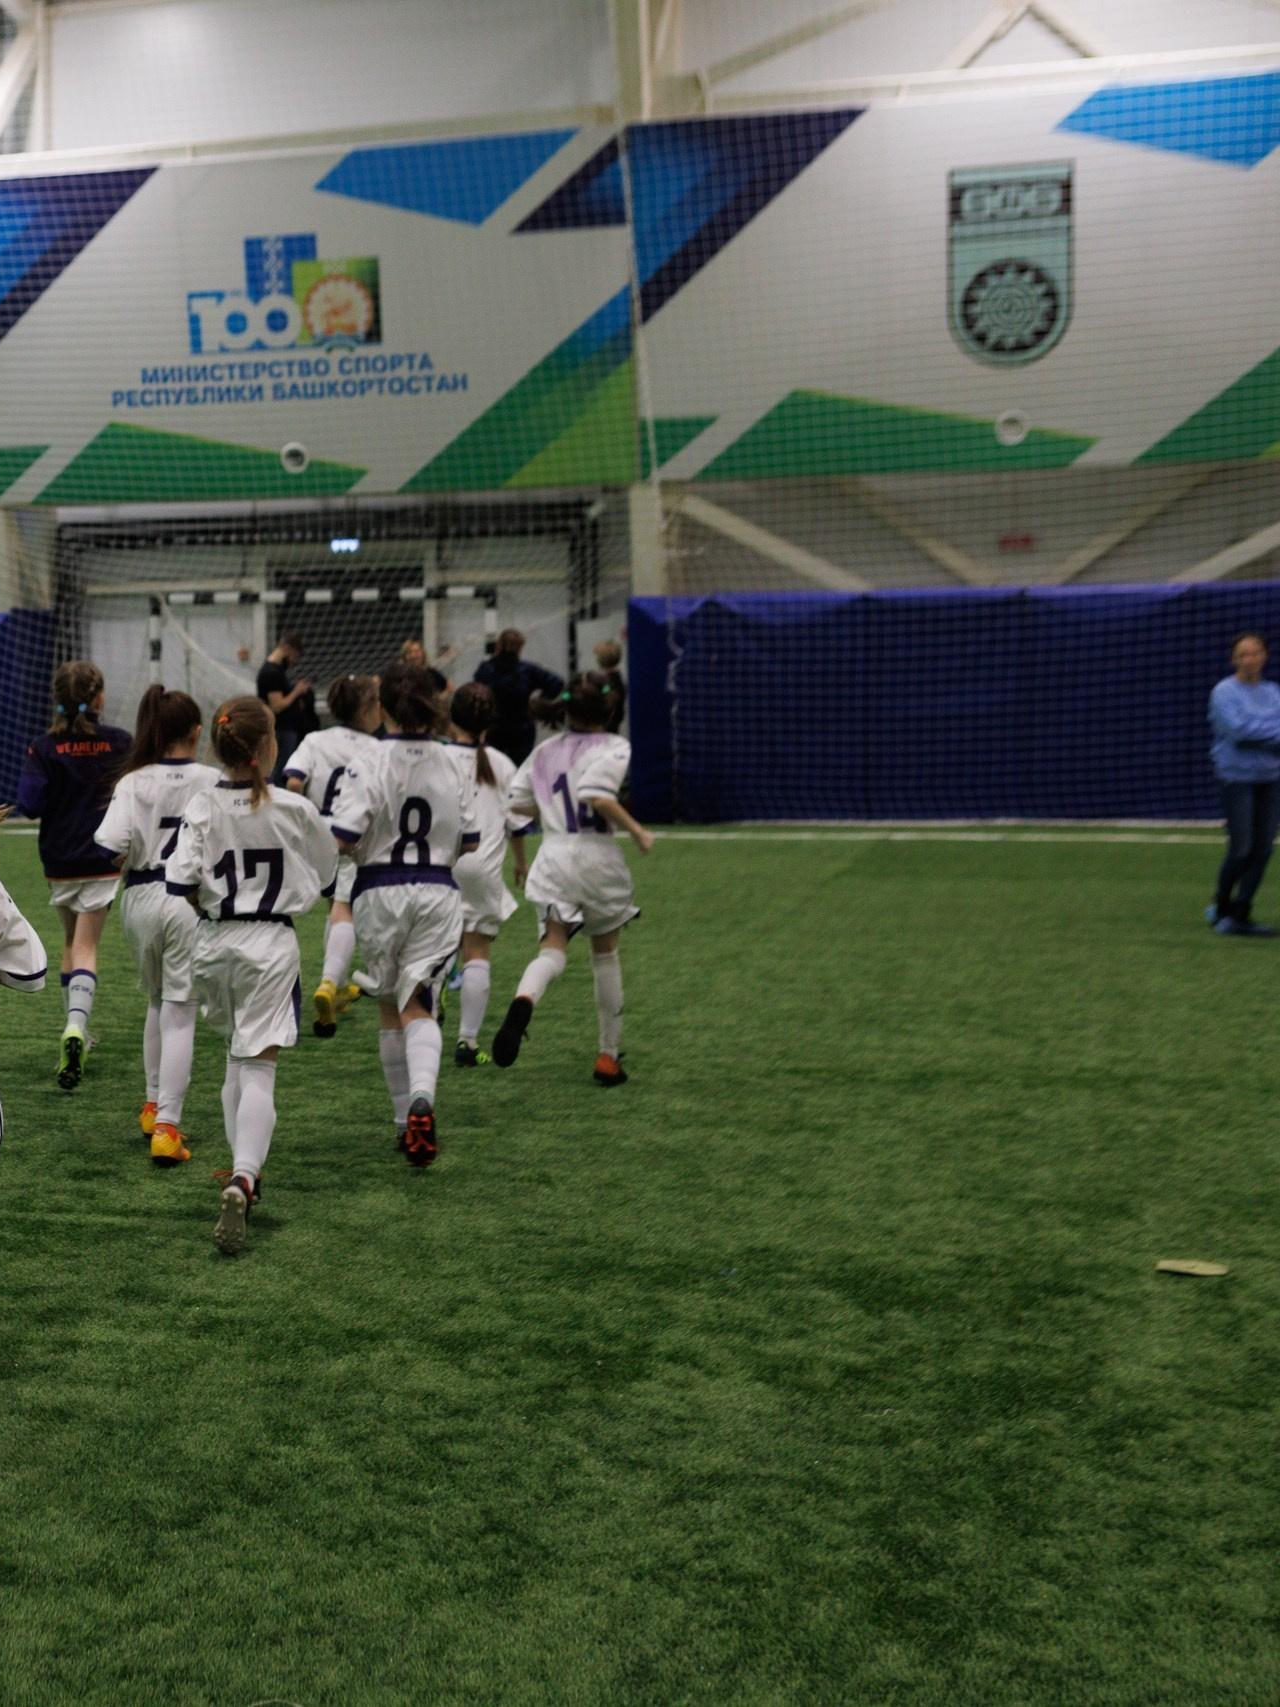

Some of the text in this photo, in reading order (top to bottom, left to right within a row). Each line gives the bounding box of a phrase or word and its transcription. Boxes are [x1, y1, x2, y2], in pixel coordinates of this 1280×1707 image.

[140, 352, 434, 386] МИНИСТЕРСТВО СПОРТА
[111, 373, 468, 408] РЕСПУБЛИКИ БАШКОРТОСТАН
[55, 741, 111, 754] WE ARE UFA
[391, 796, 432, 864] 8
[214, 848, 284, 915] 17
